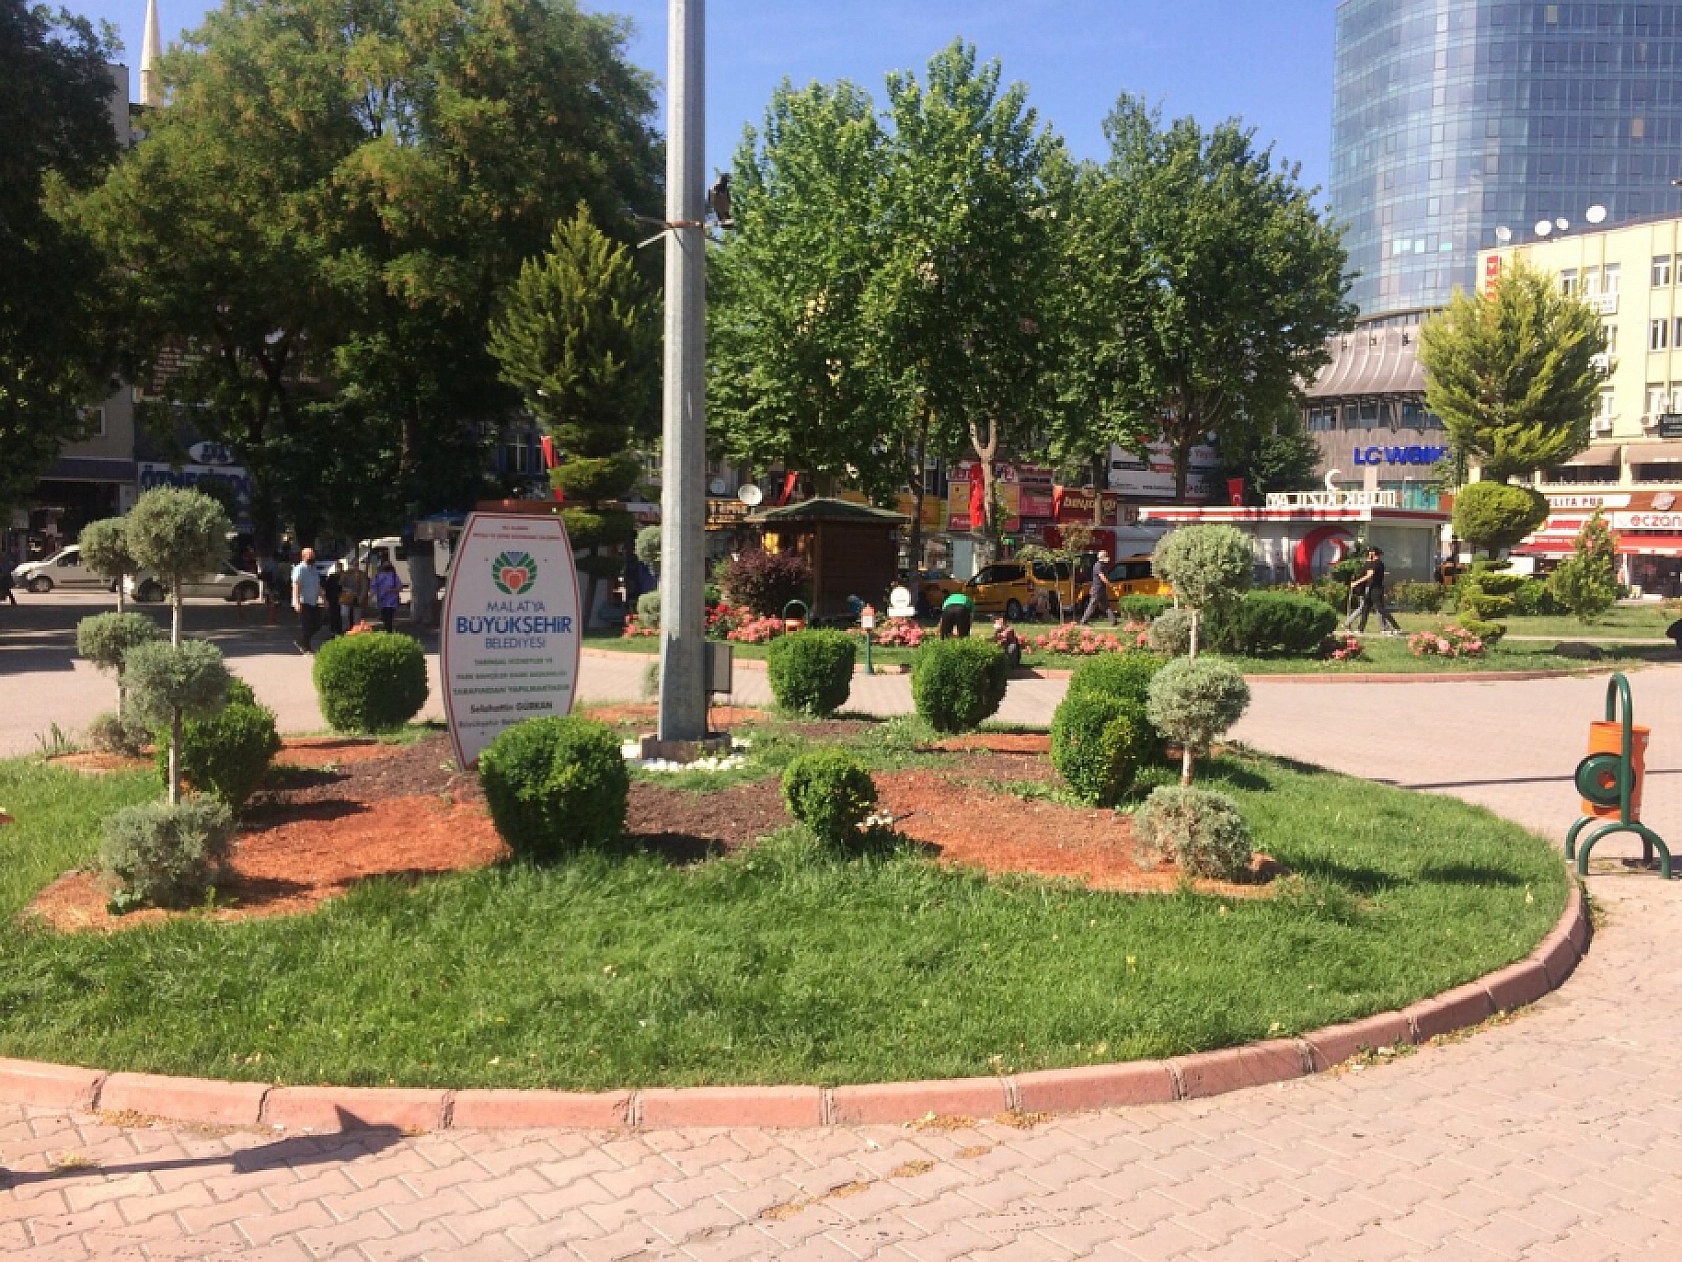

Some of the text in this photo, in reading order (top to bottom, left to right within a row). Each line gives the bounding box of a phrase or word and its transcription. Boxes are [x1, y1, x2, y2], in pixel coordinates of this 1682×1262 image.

[1353, 446, 1381, 465] LC
[486, 600, 545, 613] MALATYA
[456, 615, 572, 635] BÜYÜKŞEHİR
